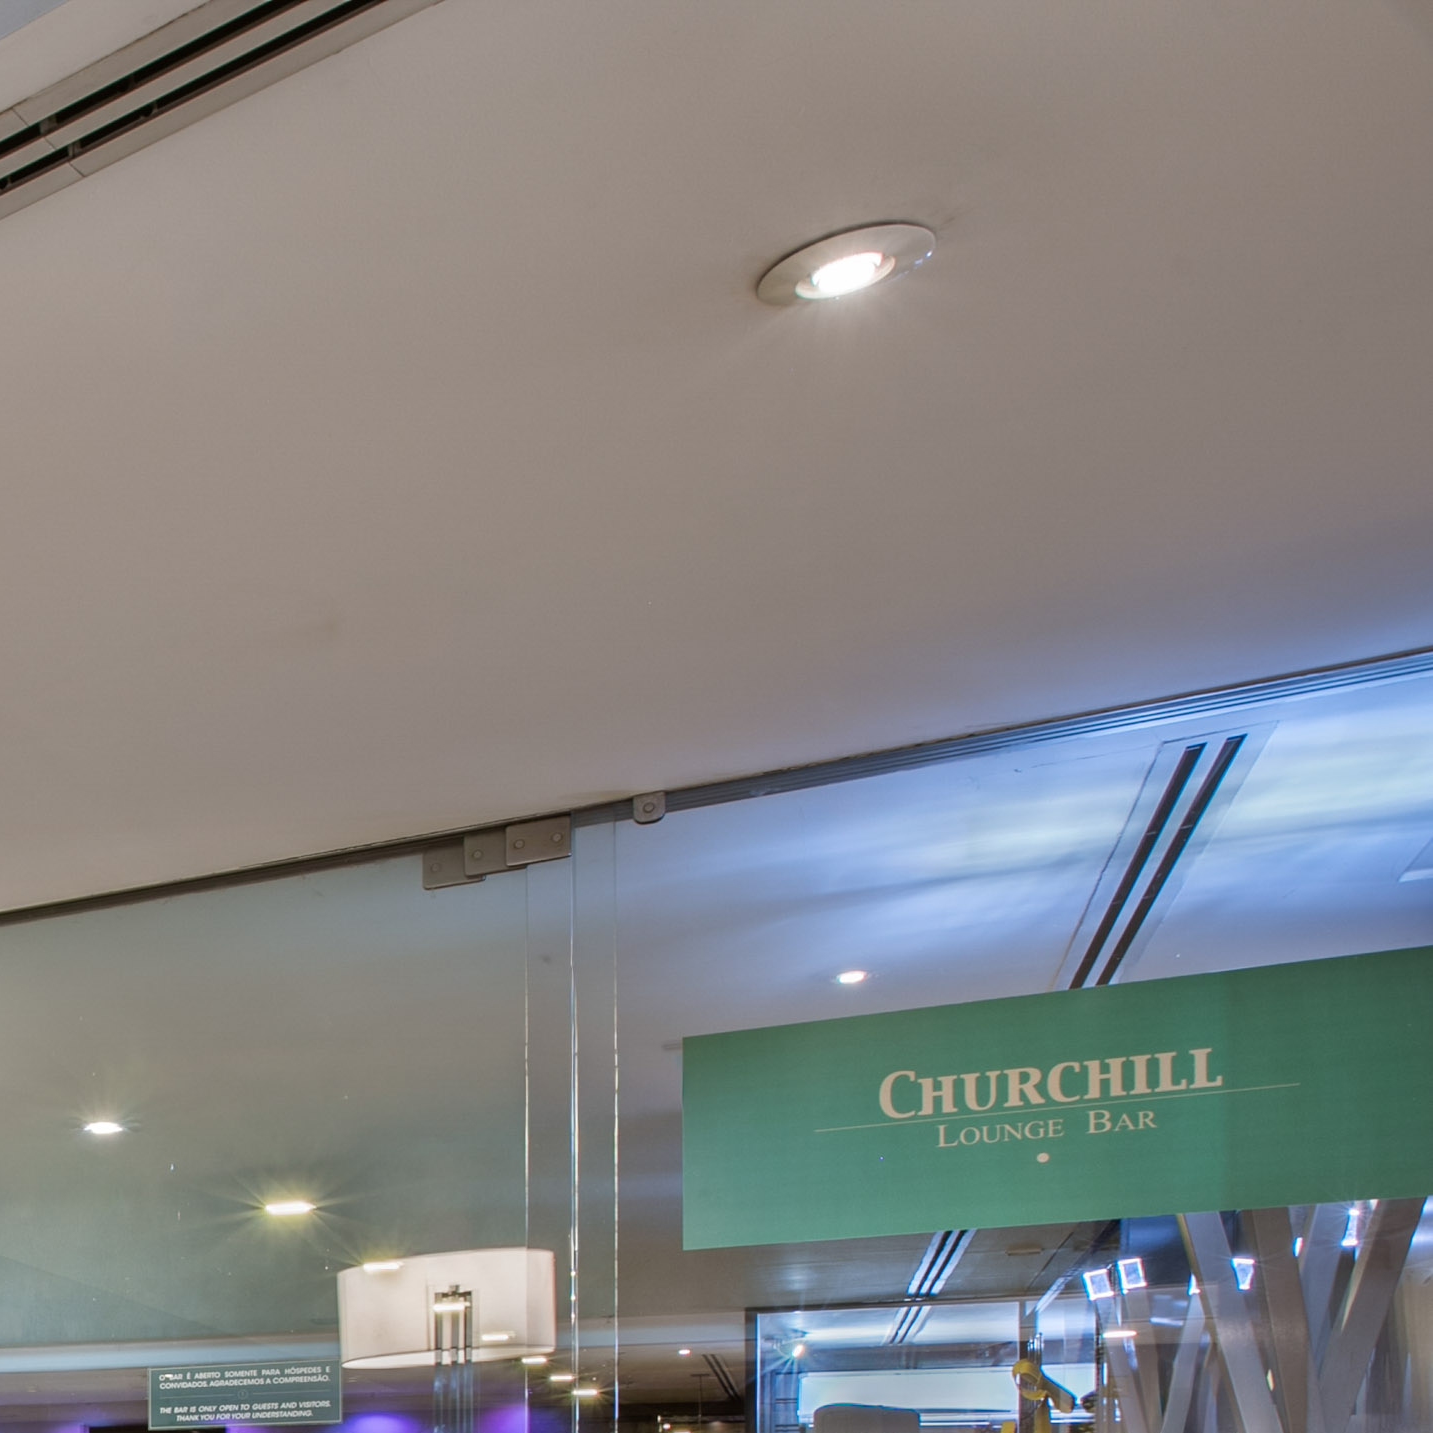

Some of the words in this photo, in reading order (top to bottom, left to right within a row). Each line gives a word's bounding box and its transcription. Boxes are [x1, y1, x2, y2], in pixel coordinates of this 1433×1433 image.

[878, 1047, 1224, 1119] CHURCHILL
[935, 1118, 1065, 1148] LOUNGE
[1086, 1108, 1158, 1134] BAR
[194, 1371, 221, 1380] ABERTO
[224, 1370, 258, 1378] SOMENTE
[261, 1368, 281, 1376] PARA
[284, 1366, 322, 1375] HÓSPEDES
[209, 1378, 265, 1387] AGRADECEMOS
[265, 1377, 272, 1385] A
[159, 1406, 172, 1414] THE
[174, 1405, 189, 1414] BAR
[189, 1405, 197, 1413] IS
[198, 1404, 218, 1413] ONLY
[219, 1403, 239, 1412] OPEN
[240, 1403, 250, 1411] TO
[251, 1402, 279, 1411] GUESTS
[280, 1401, 298, 1409] AND
[176, 1413, 200, 1422] THANK
[200, 1413, 216, 1421] YOU
[216, 1412, 231, 1420] FOR
[231, 1411, 251, 1420] YOUR
